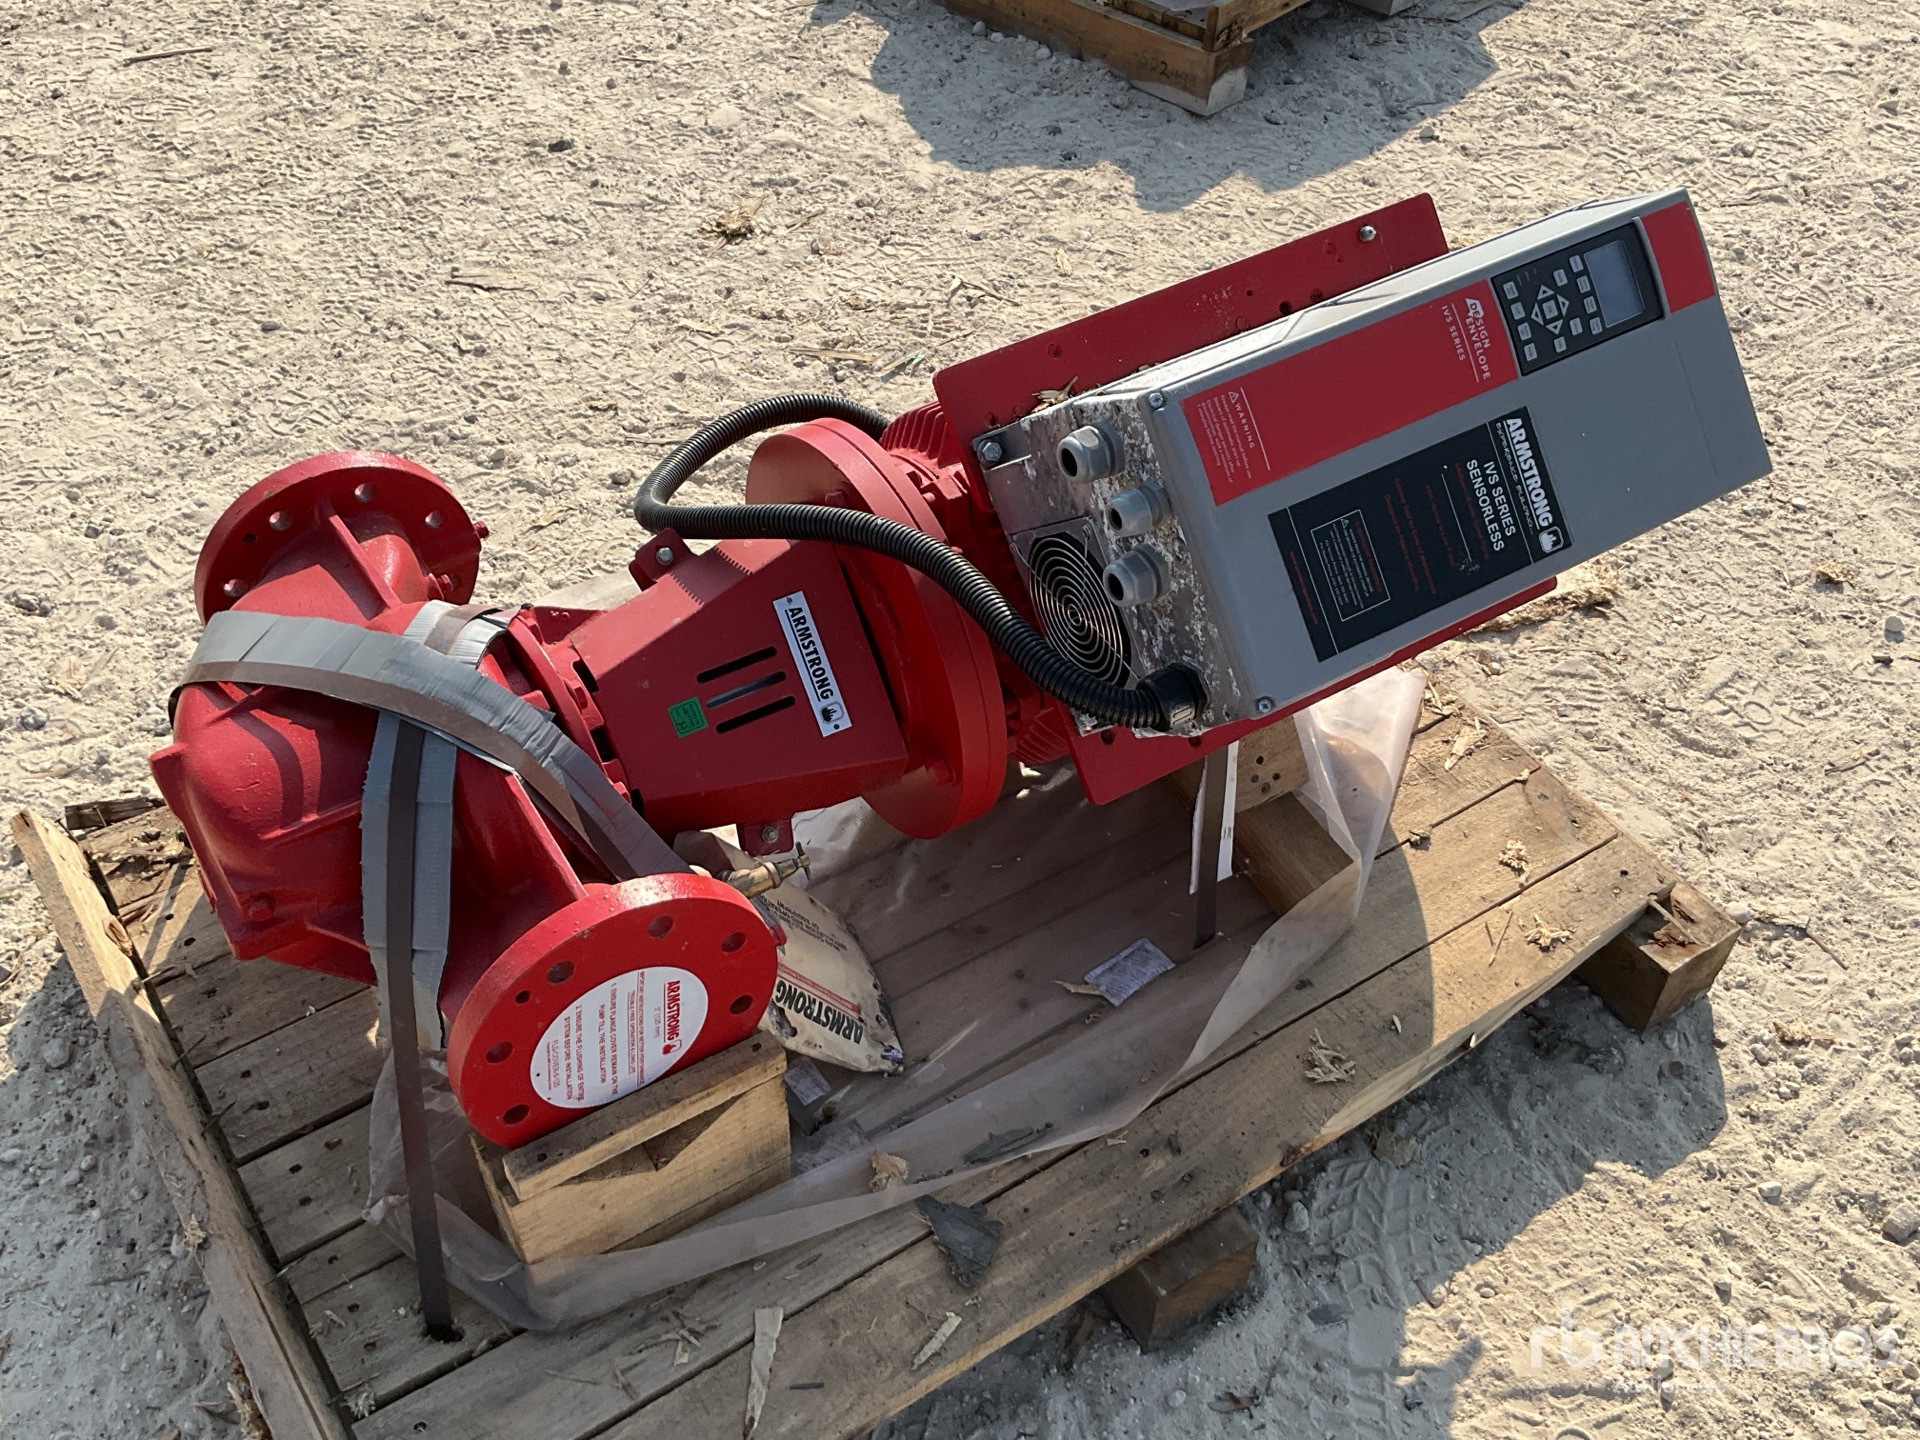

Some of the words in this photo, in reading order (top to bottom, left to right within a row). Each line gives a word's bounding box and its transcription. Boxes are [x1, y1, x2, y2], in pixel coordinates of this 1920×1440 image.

[1440, 304, 1453, 323] IVS
[1448, 324, 1466, 361] SERIES
[1468, 301, 1491, 348] DESIGN
[1464, 316, 1491, 380] ENVELOPE
[1230, 423, 1238, 434] the
[1233, 402, 1255, 449] WARNING
[1481, 460, 1500, 485] IVS
[1504, 414, 1555, 529] ARMSTRONG
[1464, 458, 1505, 552] SENSORLESS
[1490, 485, 1517, 537] SERIES
[788, 606, 834, 701] ARMSTRONG
[595, 1003, 606, 1021] PUMP
[607, 987, 618, 1011] ENSURE
[666, 978, 680, 1041] ARMSTRONG
[775, 979, 864, 1045] ARMSTRONG
[562, 1014, 571, 1039] SYSTEM
[572, 1009, 583, 1035] ENSURE
[596, 1019, 607, 1033] TILL
[608, 1009, 619, 1034] FLANGE
[563, 1037, 573, 1063] BEFORE
[574, 1032, 584, 1046] THE
[597, 1031, 608, 1045] THE
[609, 1031, 620, 1054] COVER
[574, 1043, 586, 1073] FLUSHING
[598, 1043, 610, 1084] INSTALLATION
[610, 1052, 620, 1076] REMAIN
[563, 1060, 575, 1100] INSTALLATION
[576, 1071, 587, 1082] OF
[609, 1074, 621, 1085] ON
[611, 1082, 620, 1096] THE
